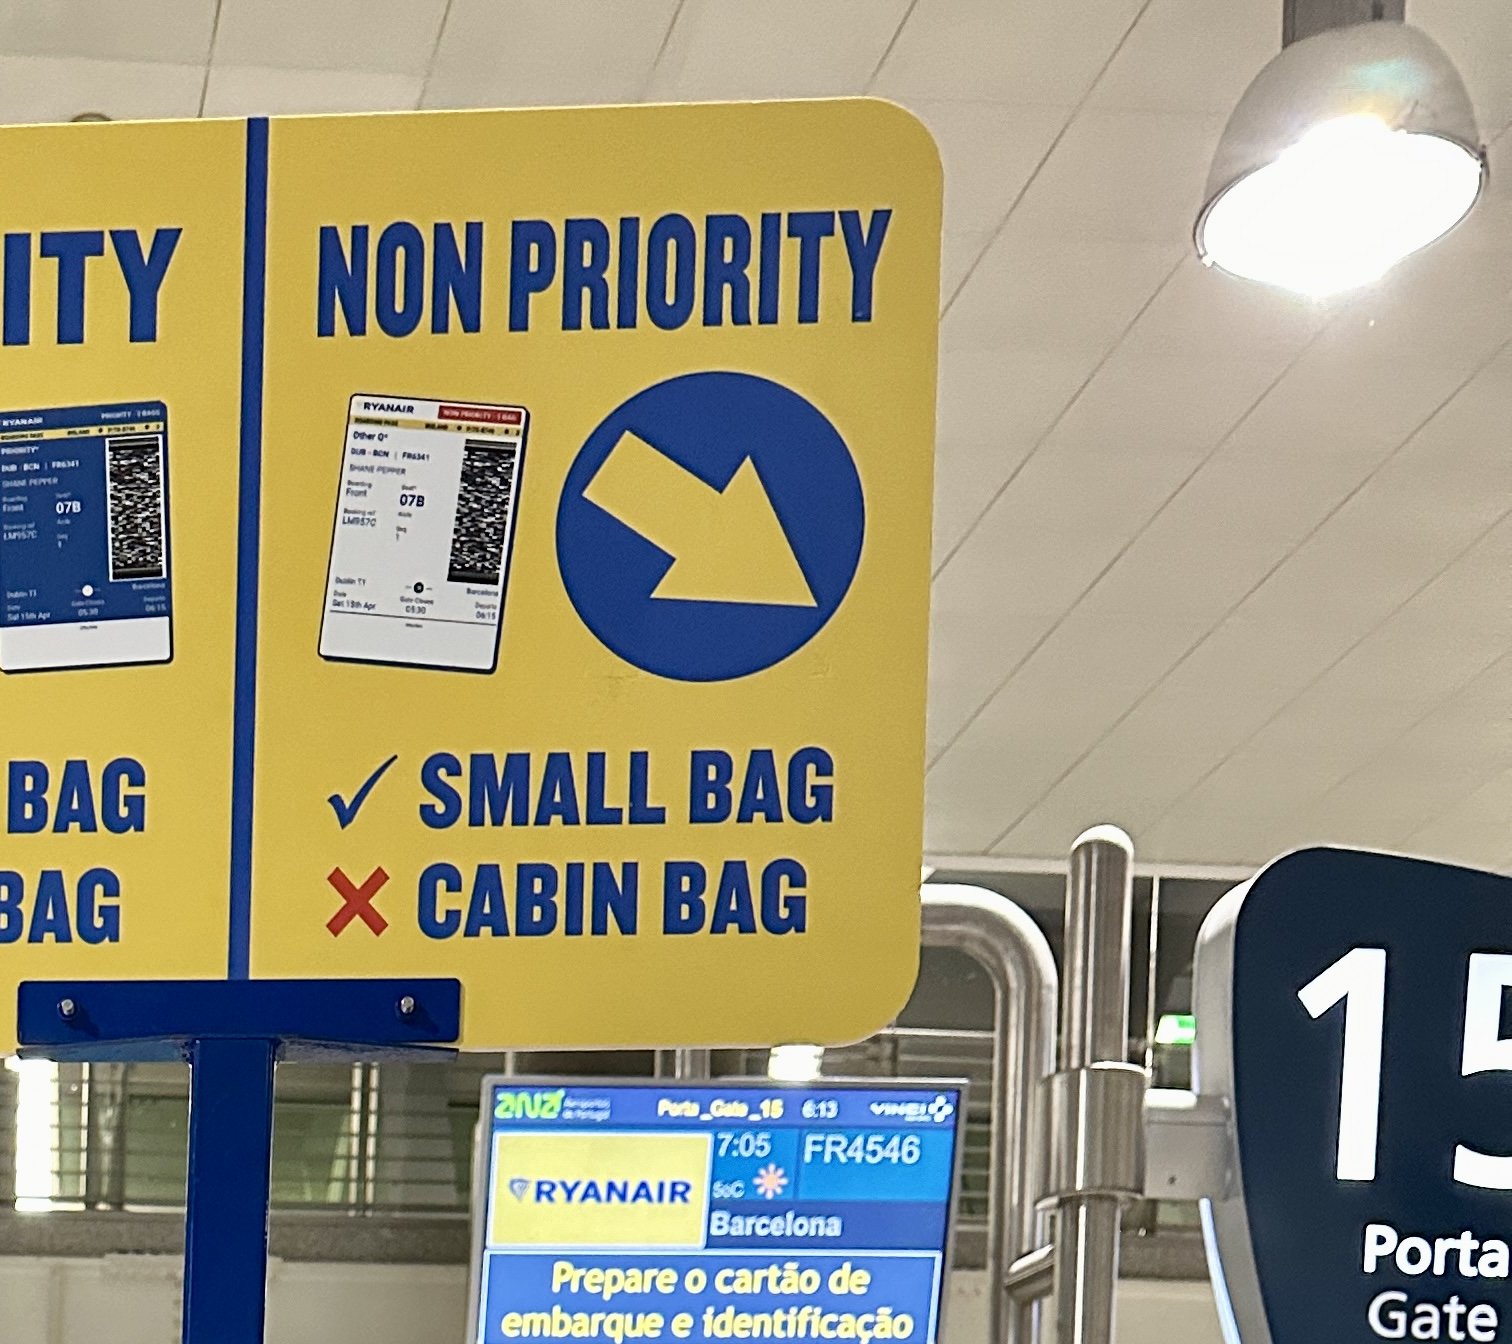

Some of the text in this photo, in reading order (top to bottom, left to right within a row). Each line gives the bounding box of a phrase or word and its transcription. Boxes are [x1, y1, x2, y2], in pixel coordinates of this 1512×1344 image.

[318, 209, 892, 337] NON PRIORITY
[363, 401, 414, 414] RYANAIR
[400, 494, 425, 507] 07B
[8, 758, 145, 834] BAG
[420, 747, 833, 829] SMALL BAG
[418, 859, 806, 939] CABIN BAG
[717, 1133, 771, 1158] 7:05
[804, 1135, 921, 1165] FR4546
[535, 1180, 692, 1204] RYANAIR
[710, 1211, 842, 1237] Barcelona
[1364, 1224, 1509, 1277] Porta
[552, 1261, 871, 1300] Prepare o cartão de
[501, 1306, 664, 1344] embarque
[671, 1314, 694, 1338] e
[1368, 1291, 1497, 1341] Gate
